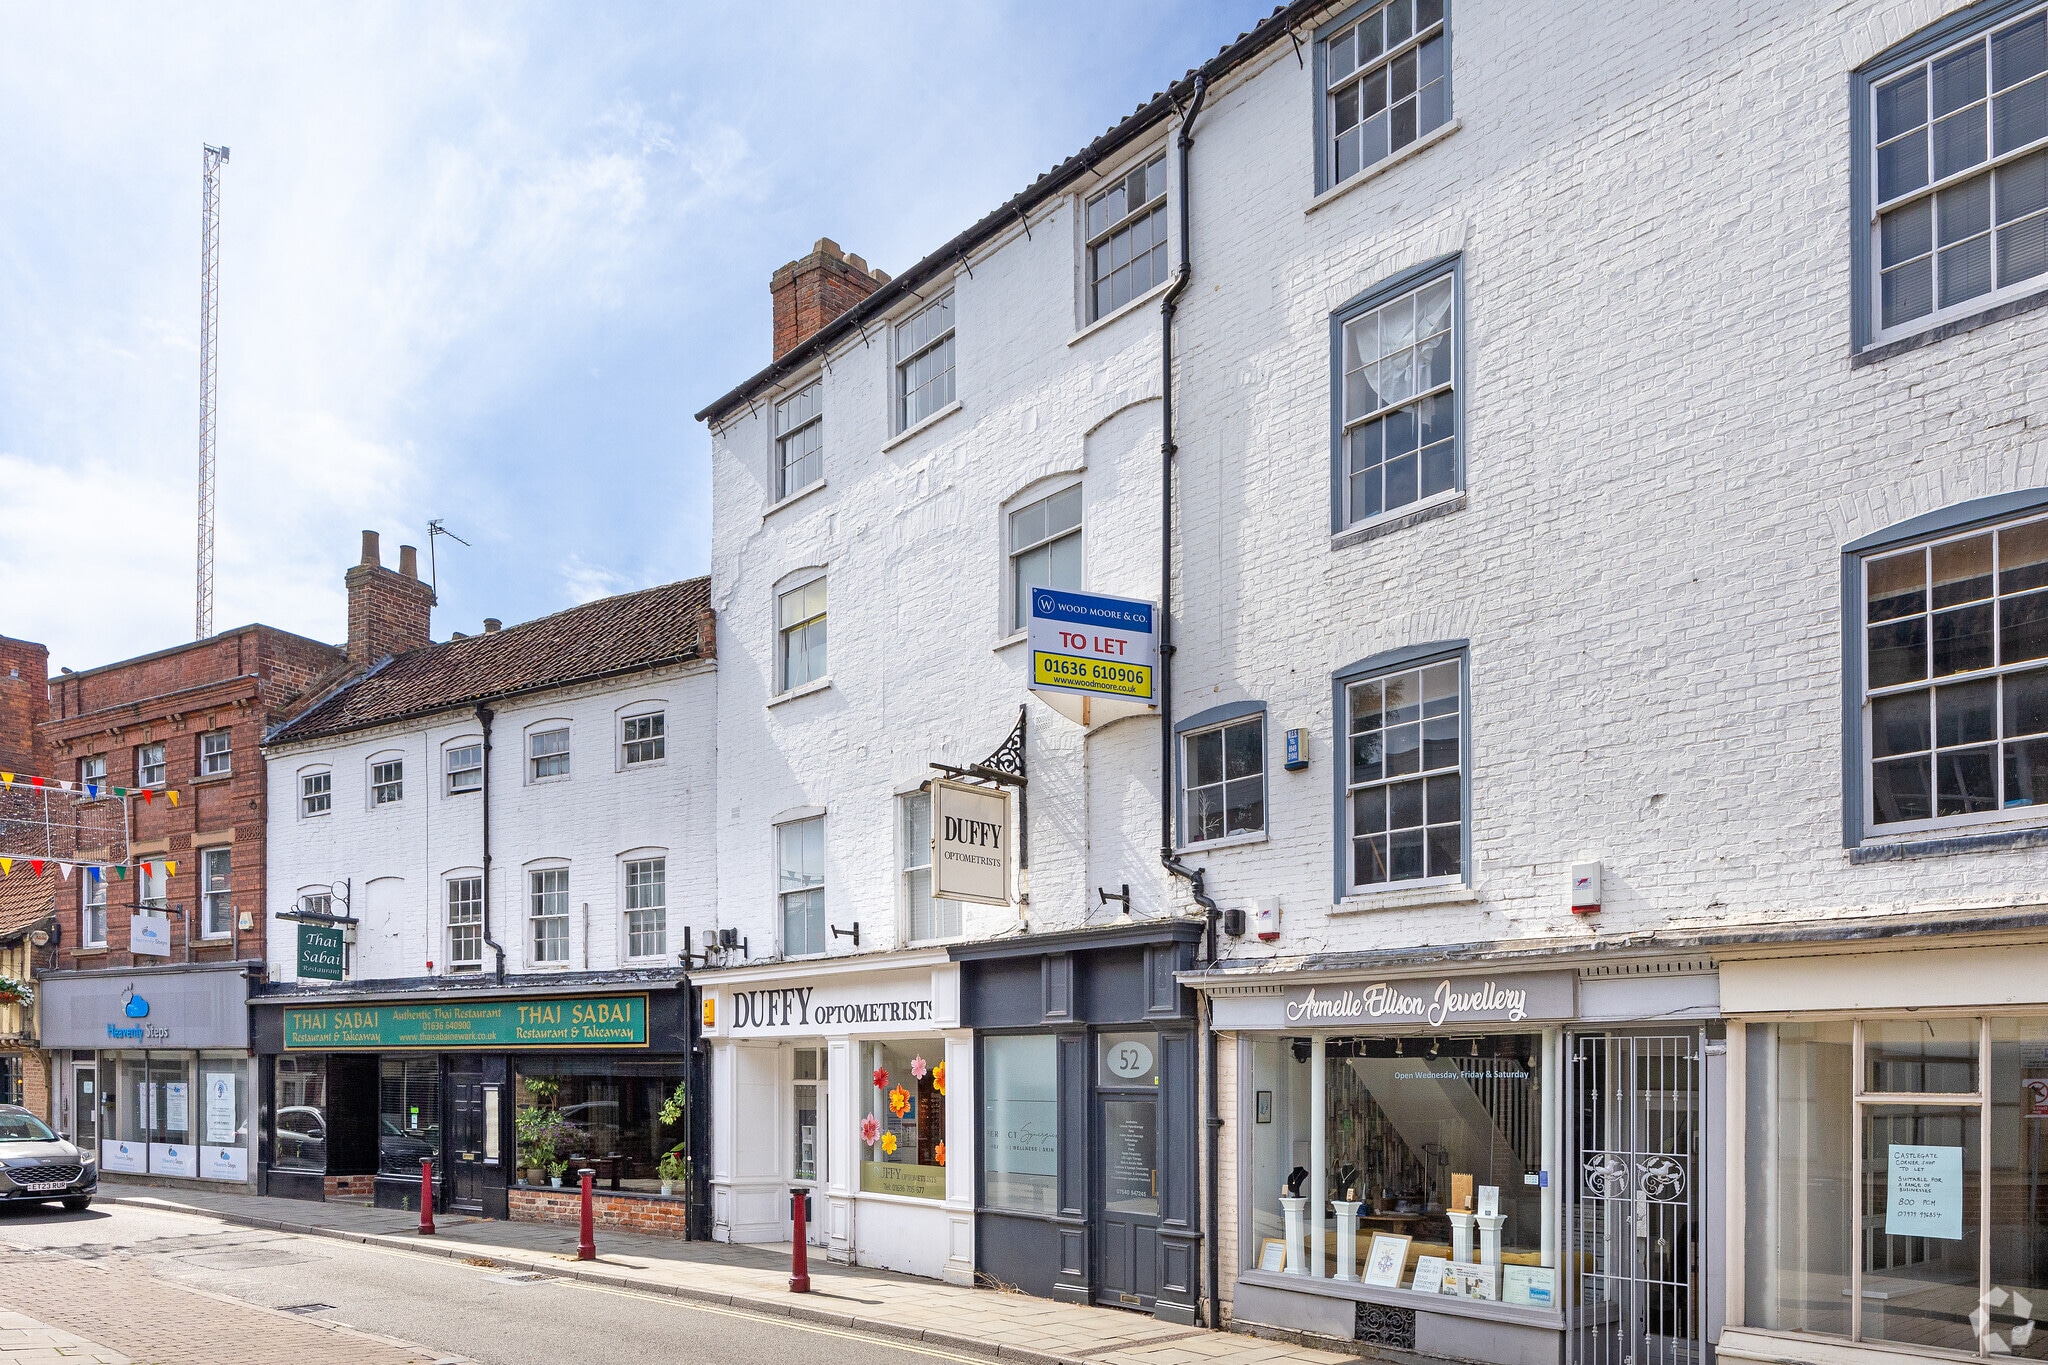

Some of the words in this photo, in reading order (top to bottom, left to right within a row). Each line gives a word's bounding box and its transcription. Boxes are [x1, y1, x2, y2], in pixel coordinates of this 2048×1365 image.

[1040, 600, 1052, 610] W
[1058, 603, 1087, 614] WOOD
[1090, 608, 1121, 620] MOORE
[1123, 612, 1131, 621] &
[1132, 614, 1148, 623] CO.
[1059, 632, 1087, 650] TO
[1094, 636, 1128, 656] LET
[1044, 658, 1087, 676] 01636
[1092, 665, 1144, 684] 610906
[1054, 676, 1136, 693] www.woodmoore.co.uk
[944, 816, 1002, 849] DUFFY
[944, 851, 1001, 868] OPTOMETRISTS
[306, 932, 338, 948] Thai
[302, 950, 340, 965] Sabai
[302, 965, 340, 974] Restaurant
[732, 986, 814, 1028] DUFFY
[1286, 988, 1363, 1021] Armelle
[1363, 982, 1426, 1017] Ellison
[1428, 979, 1528, 1027] Jewellery
[293, 1013, 326, 1030] THAI
[334, 1011, 378, 1029] SABAI
[393, 1009, 431, 1020] Authentic
[434, 1008, 452, 1019] Thai
[454, 1008, 501, 1019] Restaurant
[517, 1005, 561, 1024] THAI
[572, 1003, 631, 1024] SABAI
[107, 1022, 143, 1043] Heavenly
[145, 1022, 169, 1043] Steps
[422, 1022, 444, 1030] 01636
[516, 1027, 568, 1039] Restaurant
[571, 1027, 579, 1038] &
[582, 1024, 634, 1040] Takeaway
[292, 1032, 332, 1042] Restaurant
[334, 1032, 340, 1041] &
[342, 1030, 380, 1044] Takeaway
[399, 1031, 497, 1041] www.thaisabainewark.co.uk
[1120, 1049, 1139, 1070] 52
[1394, 1072, 1413, 1080] Open
[1415, 1071, 1459, 1080] Wednesday,
[1460, 1070, 1484, 1079] Friday
[1494, 1070, 1529, 1079] Saturday
[1020, 1122, 1057, 1144] Synergie
[1898, 1198, 1915, 1206] 800
